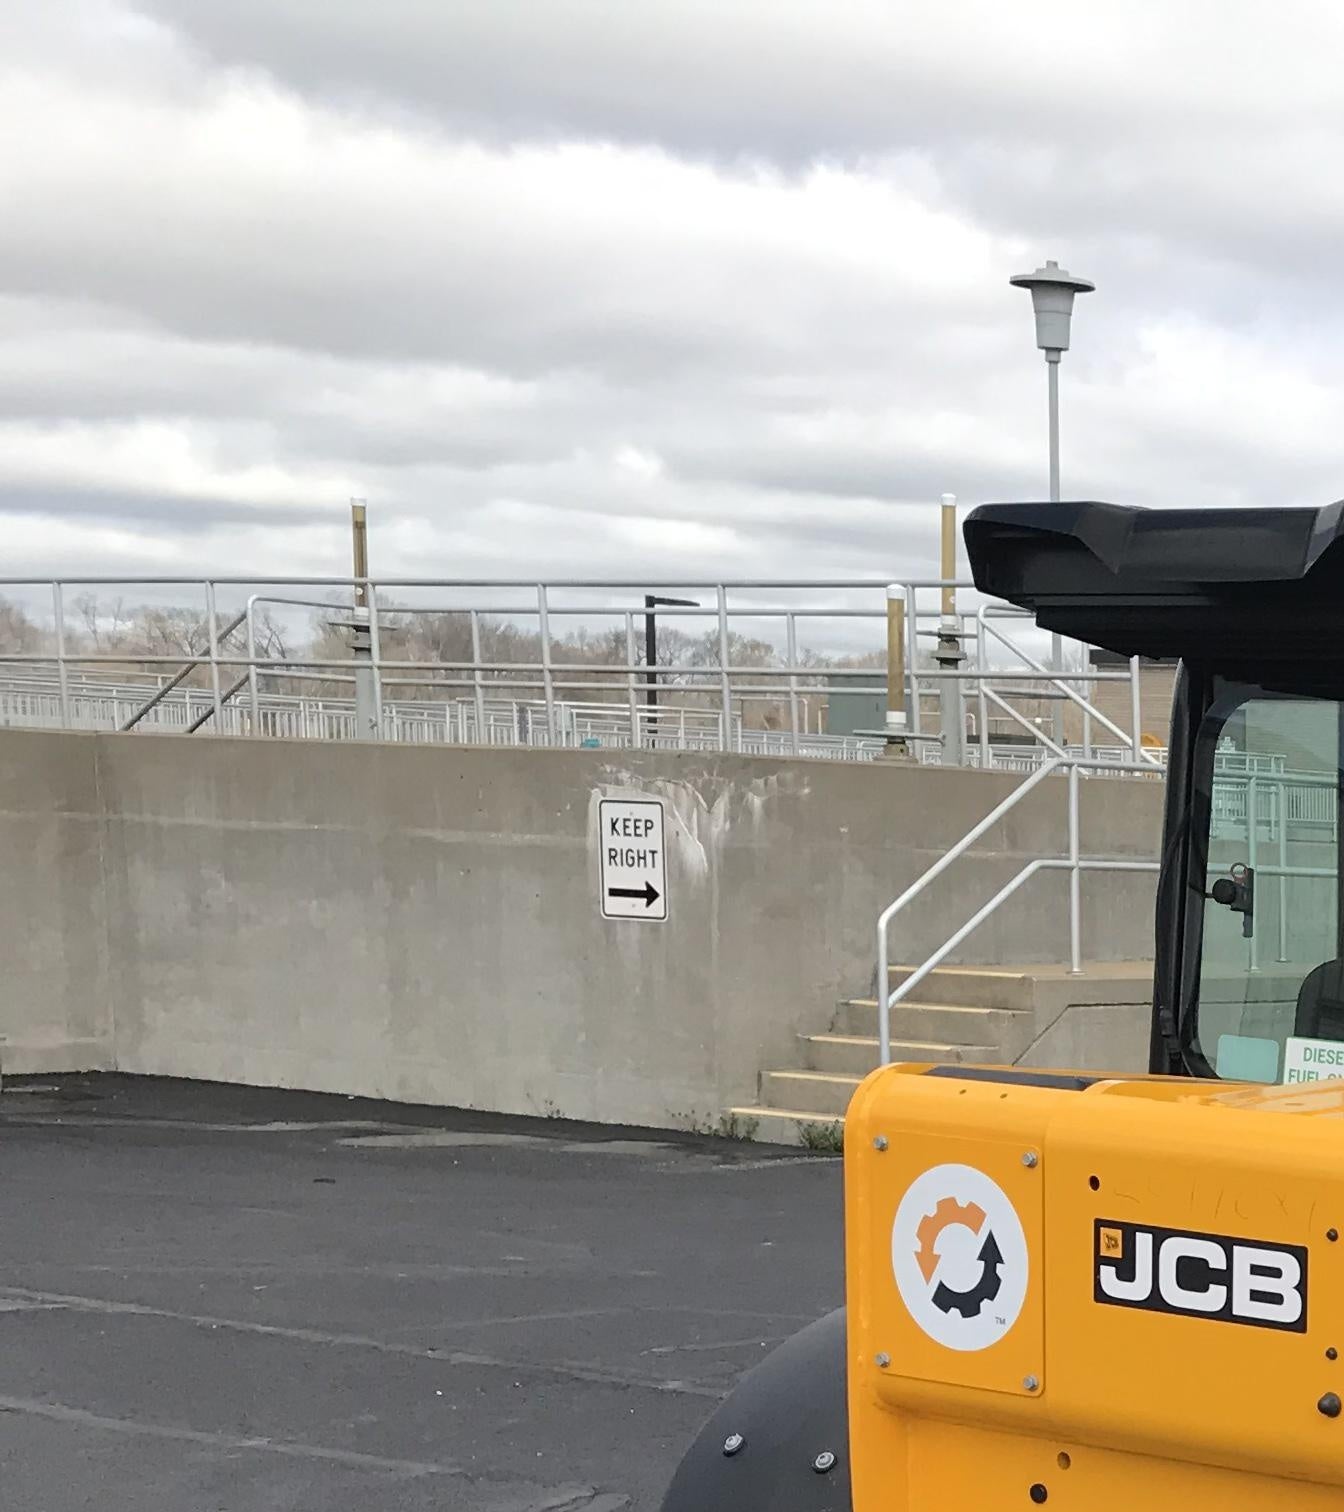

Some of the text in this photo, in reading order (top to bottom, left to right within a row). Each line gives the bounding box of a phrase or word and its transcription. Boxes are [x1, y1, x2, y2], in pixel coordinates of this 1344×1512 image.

[610, 817, 654, 838] KEEP
[608, 848, 658, 869] RIGHT
[1099, 1231, 1302, 1323] JCB
